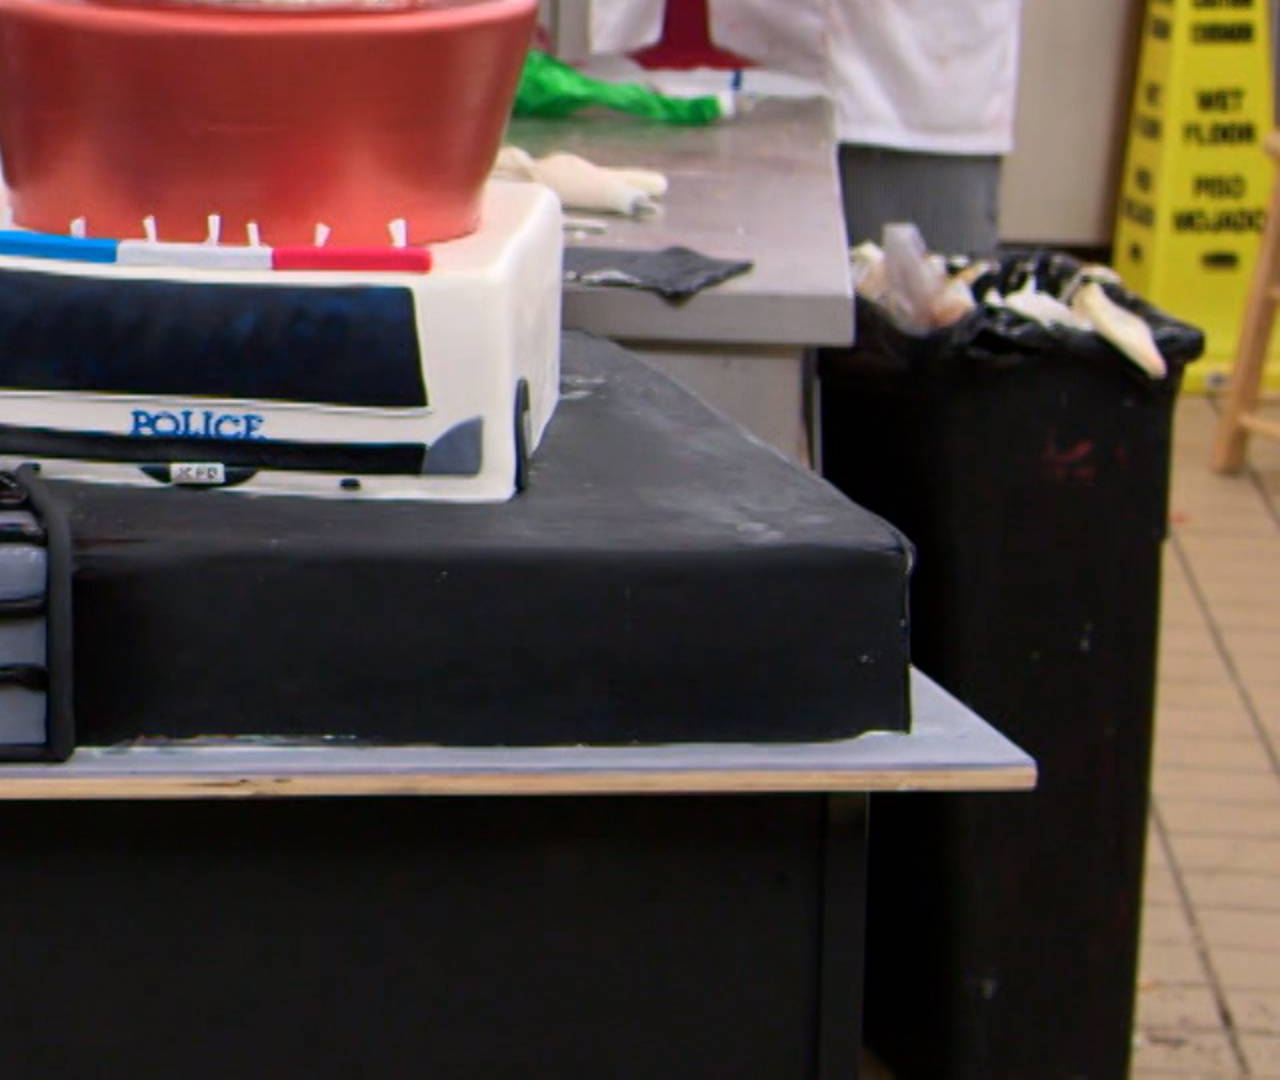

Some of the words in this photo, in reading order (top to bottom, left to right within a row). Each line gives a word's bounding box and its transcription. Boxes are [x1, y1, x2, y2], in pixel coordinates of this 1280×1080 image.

[1195, 89, 1246, 112] WET
[1182, 123, 1256, 146] FLOOR
[130, 409, 267, 441] POLICE
